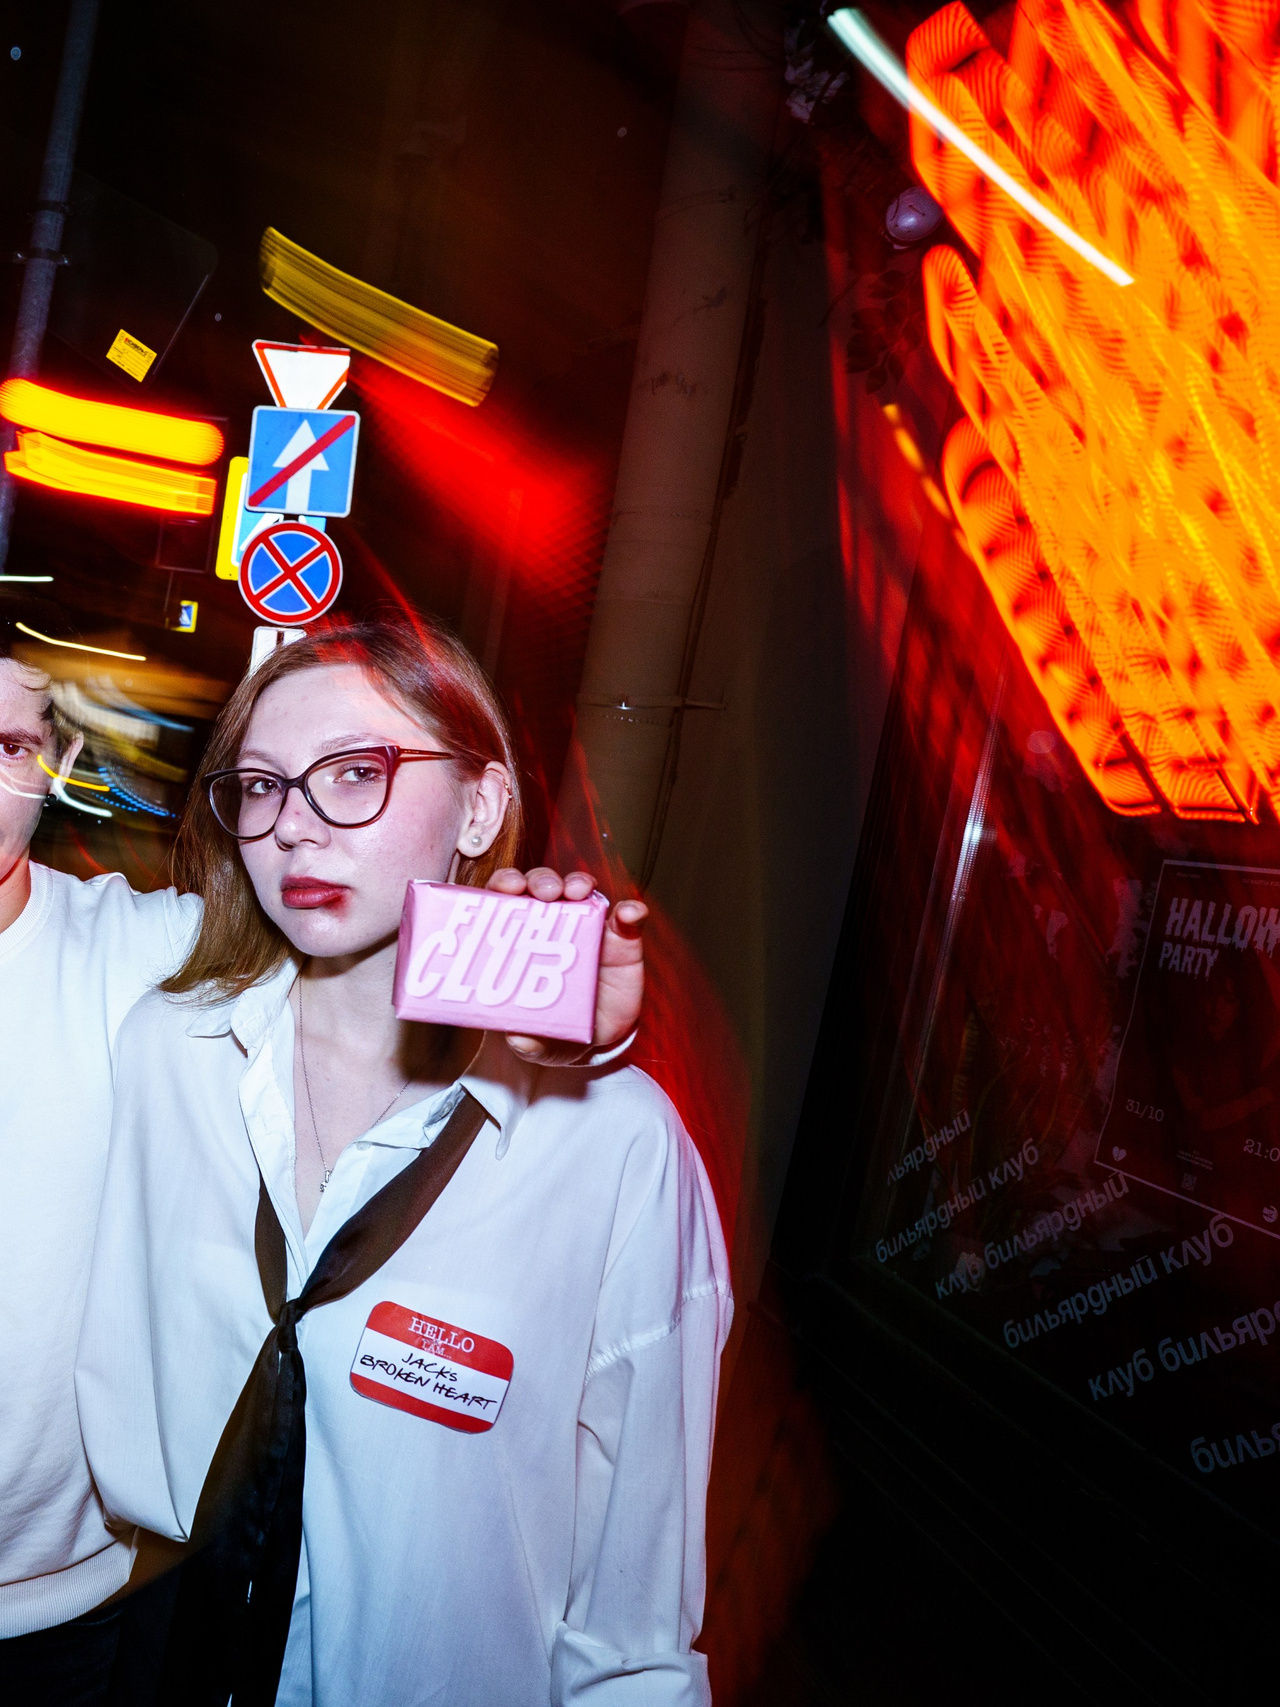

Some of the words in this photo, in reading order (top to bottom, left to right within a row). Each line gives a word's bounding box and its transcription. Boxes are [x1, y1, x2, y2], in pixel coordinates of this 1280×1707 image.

[444, 893, 591, 943] FIGHT
[404, 931, 577, 1010] CLUB
[1158, 941, 1219, 981] PARTY
[1125, 1099, 1165, 1122] 31/10
[1243, 1138, 1280, 1162] 21:0
[875, 1176, 987, 1264] бильярдный
[988, 1137, 1040, 1191] клуб
[933, 1251, 983, 1299] клуб
[984, 1170, 1130, 1270] бильярдный
[1002, 1255, 1159, 1349] бильярдный
[1159, 1213, 1234, 1274] клуб
[408, 1316, 475, 1353] HELLO
[360, 1354, 431, 1387] BROKEN
[433, 1382, 498, 1410] HEART
[1087, 1348, 1155, 1401] клуб
